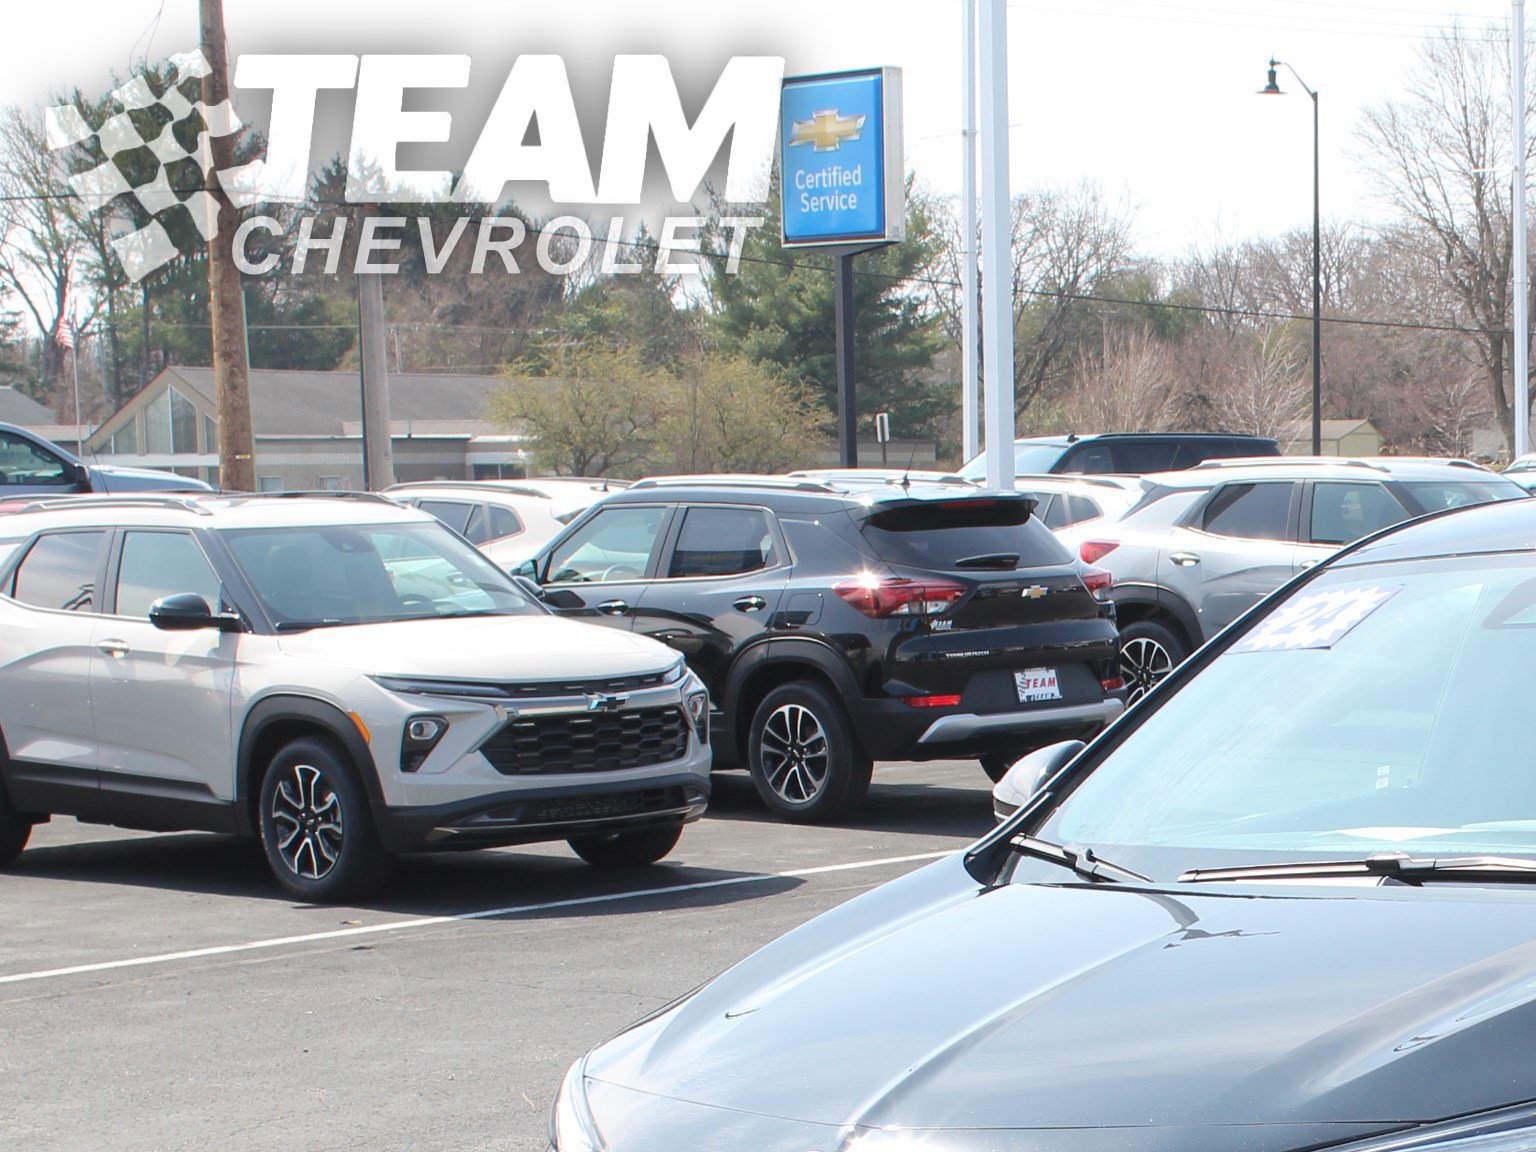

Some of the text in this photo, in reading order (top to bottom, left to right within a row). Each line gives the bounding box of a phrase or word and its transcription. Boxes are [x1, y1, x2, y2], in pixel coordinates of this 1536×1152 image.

[795, 165, 861, 189] Certified
[800, 191, 857, 213] Service
[1271, 600, 1359, 633] 24
[1025, 677, 1056, 689] TEAM
